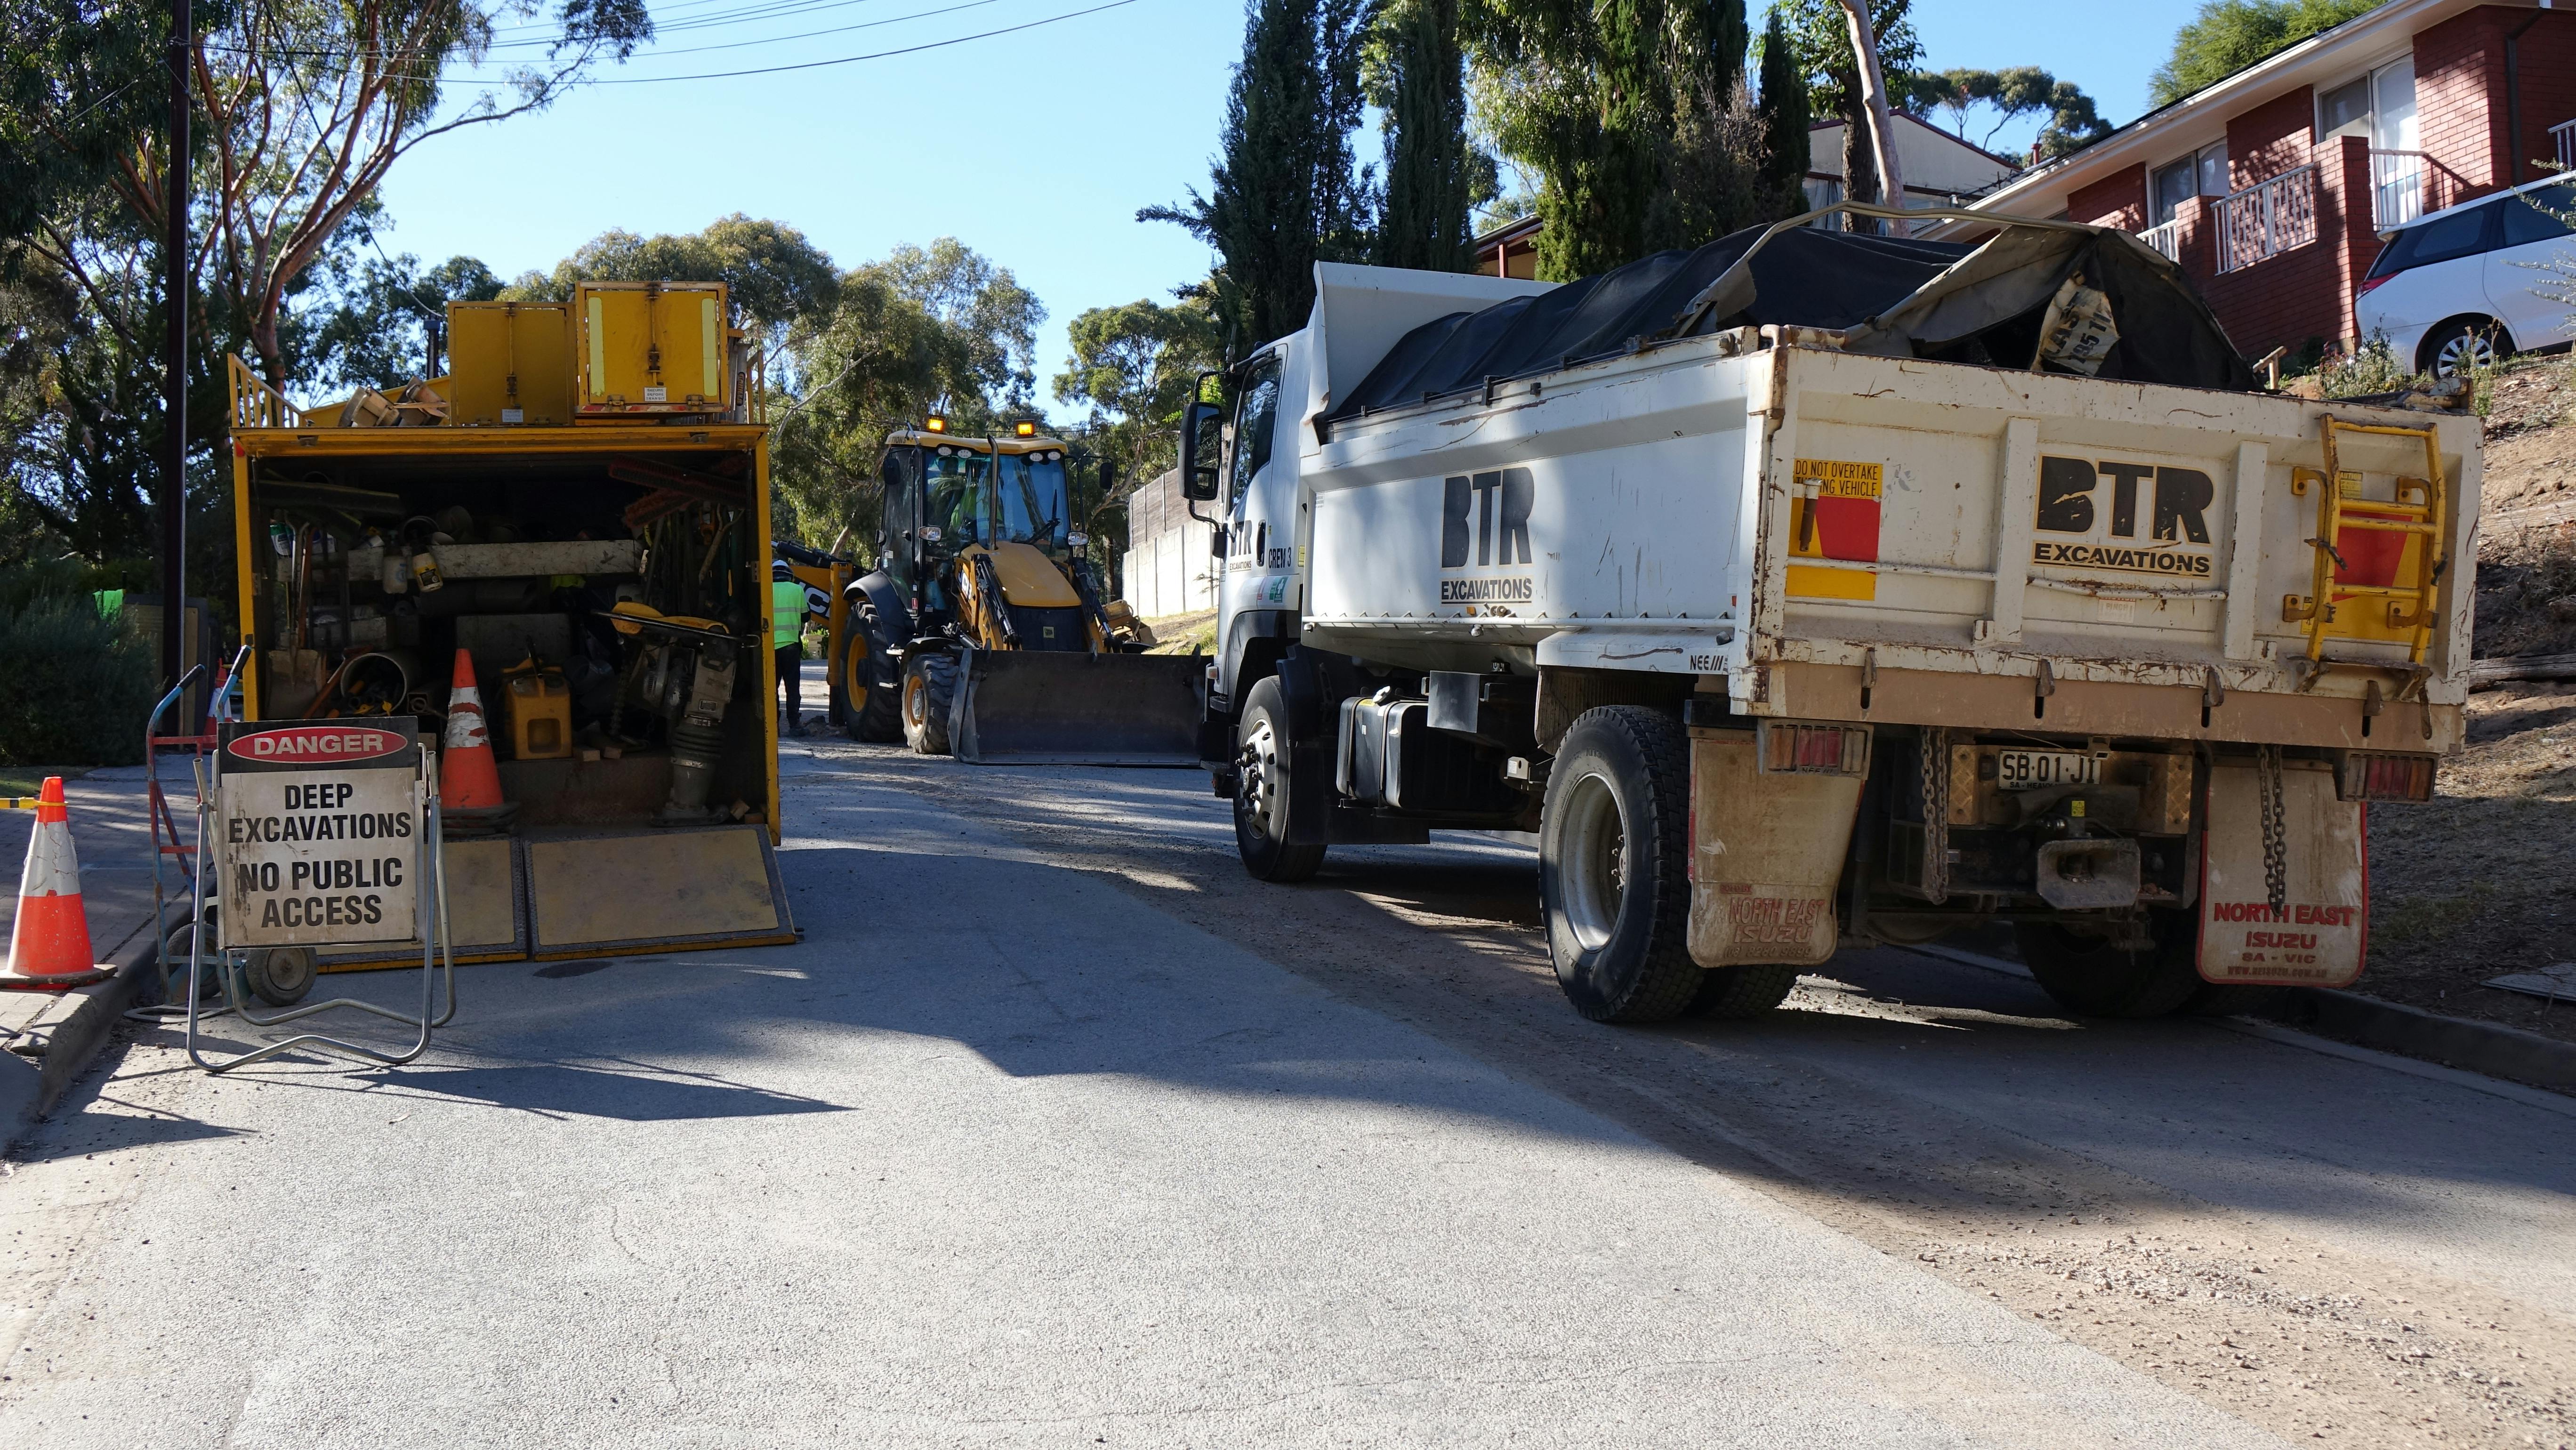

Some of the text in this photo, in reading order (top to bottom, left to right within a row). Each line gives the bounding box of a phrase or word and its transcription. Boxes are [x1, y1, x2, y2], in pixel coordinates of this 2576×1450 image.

[1795, 460, 1878, 480] DO NOT OVERTAKE
[1839, 480, 1877, 497] VEHICLE
[2037, 456, 2214, 544] BTR
[1441, 467, 1534, 568] BTR
[1230, 561, 1251, 571] EXCAVATIONS
[1268, 548, 1286, 569] CREW
[1287, 547, 1291, 567] 3
[2034, 542, 2210, 573] EXCAVATIONS
[1441, 578, 1532, 600] EXCAVATIONS
[254, 734, 384, 756] DANGER
[285, 783, 353, 810] DEEP
[229, 812, 411, 843] EXCAVATIONS
[239, 857, 402, 892] NO PUBLIC
[261, 895, 382, 928] ACCESS
[1729, 897, 1825, 925] NORTH EAST
[2214, 902, 2355, 926] NORTH EAST
[1734, 925, 1813, 943] ISUZU
[2246, 931, 2317, 949] ISUZU
[2242, 953, 2265, 962] SA
[2285, 954, 2316, 964] VIC
